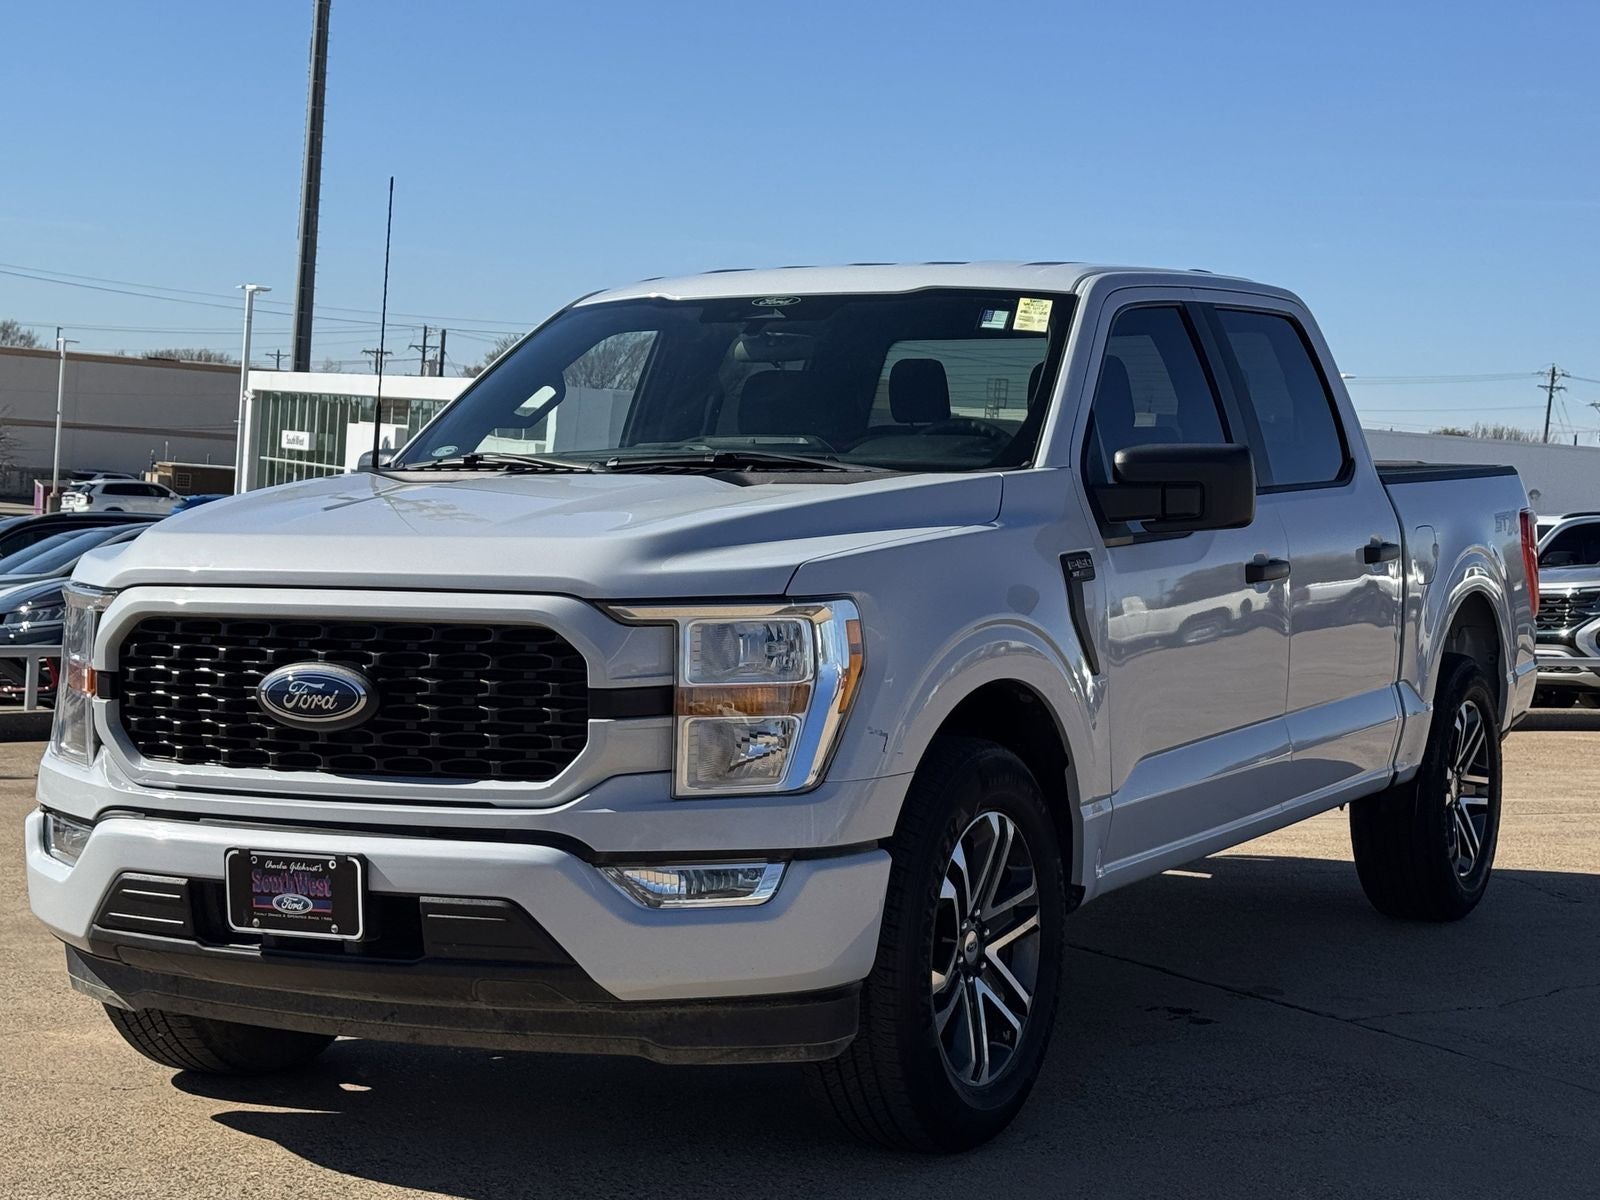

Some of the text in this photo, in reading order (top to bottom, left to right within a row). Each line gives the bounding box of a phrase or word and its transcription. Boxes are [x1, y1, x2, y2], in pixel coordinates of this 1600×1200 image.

[283, 681, 339, 710] Ford
[251, 868, 332, 897] SouthWest
[281, 897, 304, 910] Ford
